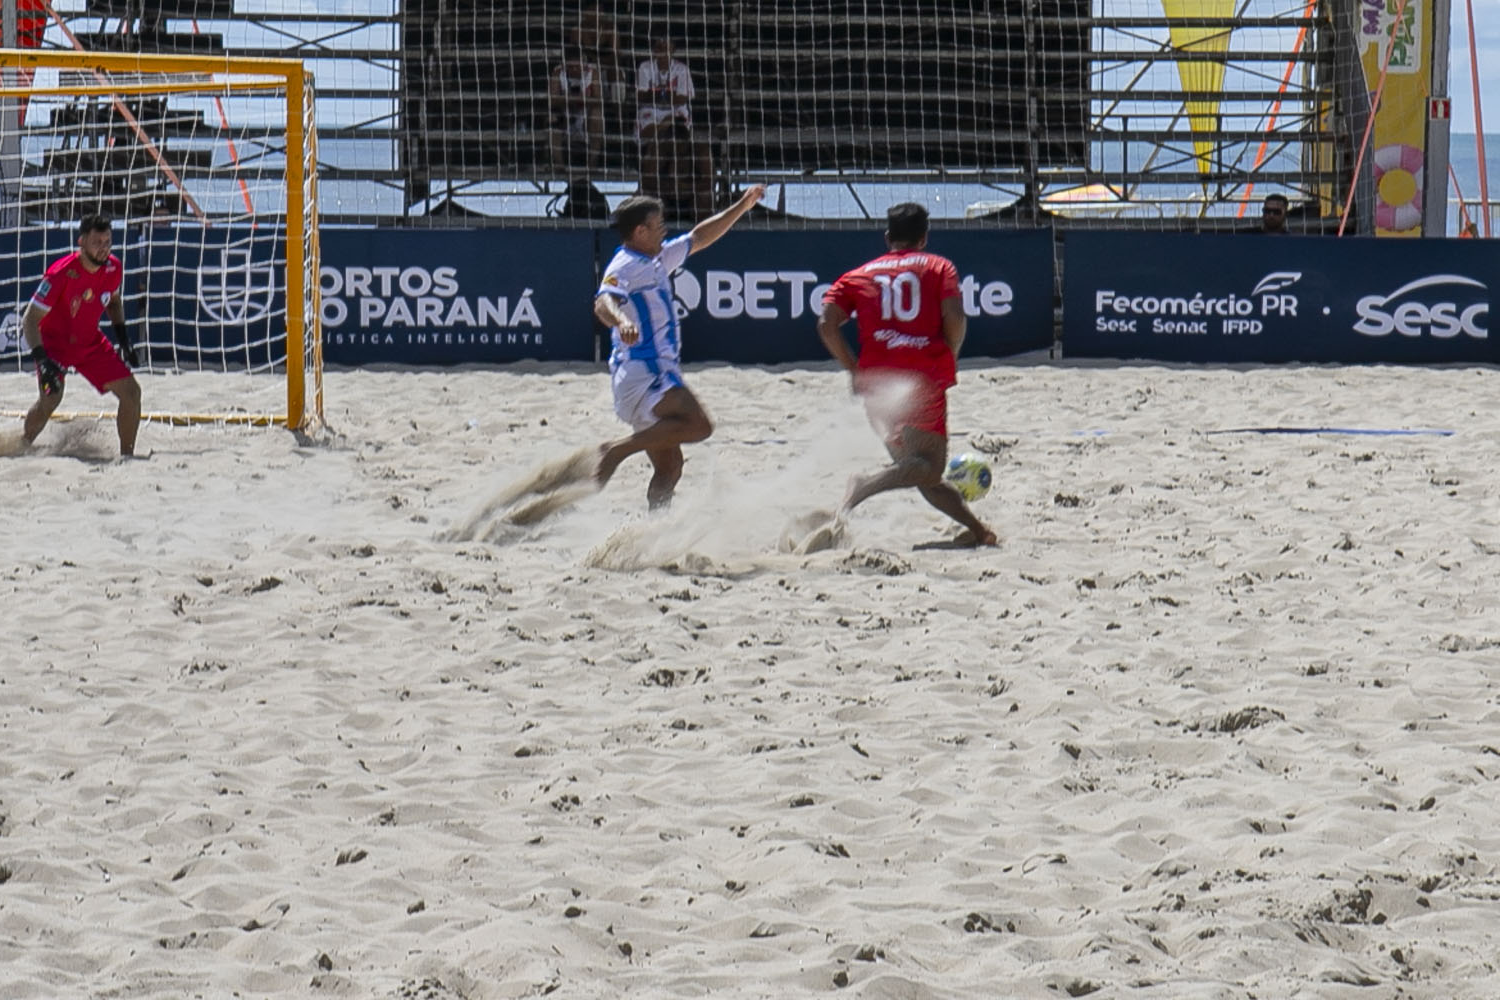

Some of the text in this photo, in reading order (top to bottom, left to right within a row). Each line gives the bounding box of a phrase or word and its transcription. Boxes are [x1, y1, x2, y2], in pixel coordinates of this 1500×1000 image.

[320, 266, 458, 298] ORTOS
[873, 271, 921, 321] 10
[360, 289, 542, 328] PARANÁ
[1096, 290, 1298, 317] Fecomércio PR
[1352, 292, 1490, 338] Sesc
[326, 332, 543, 345] ÍSTICA INTELIGENTE
[1096, 317, 1263, 335] Sesc Senac IFPD
